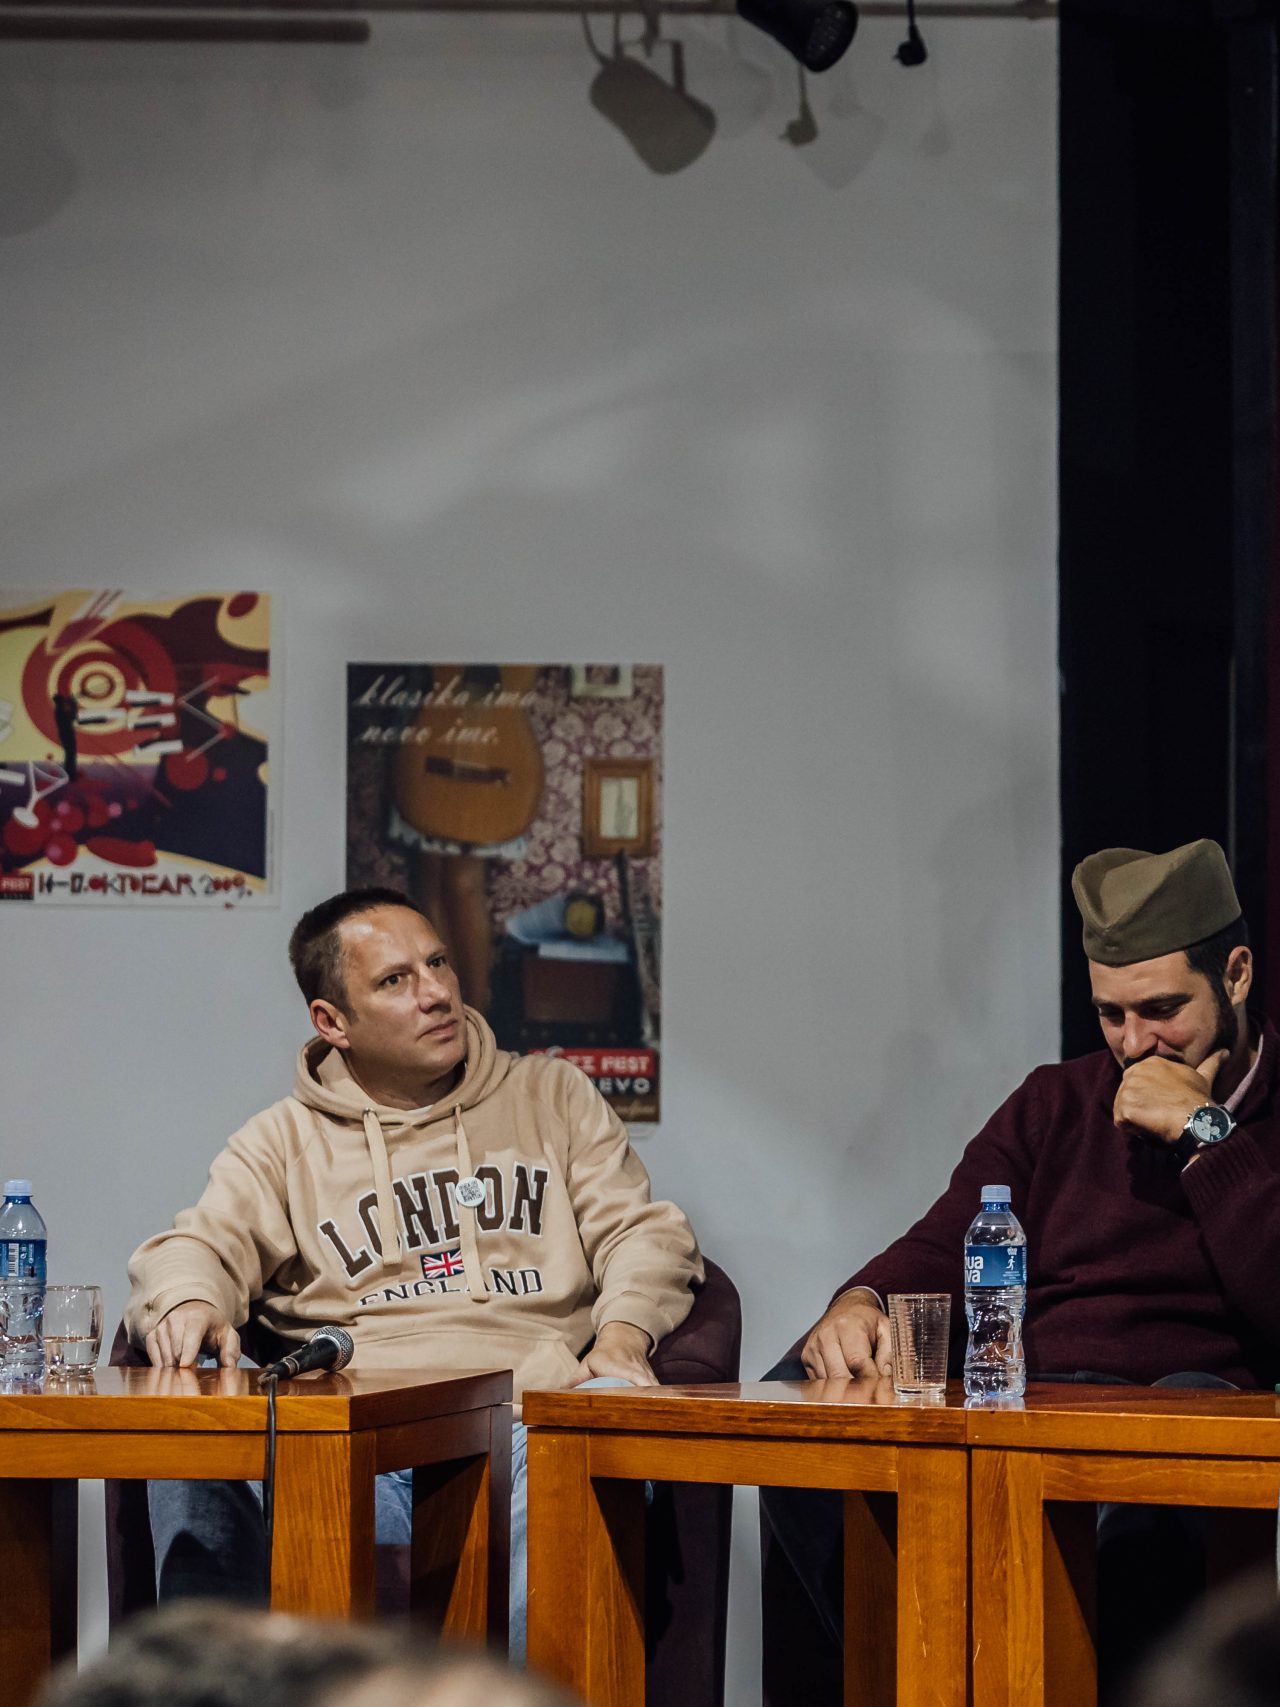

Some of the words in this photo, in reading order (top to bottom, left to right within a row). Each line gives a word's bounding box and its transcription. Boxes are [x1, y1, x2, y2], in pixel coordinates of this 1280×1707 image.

[592, 1077, 651, 1095] EVO
[965, 1255, 984, 1270] ua
[358, 1267, 544, 1307] ENGLND
